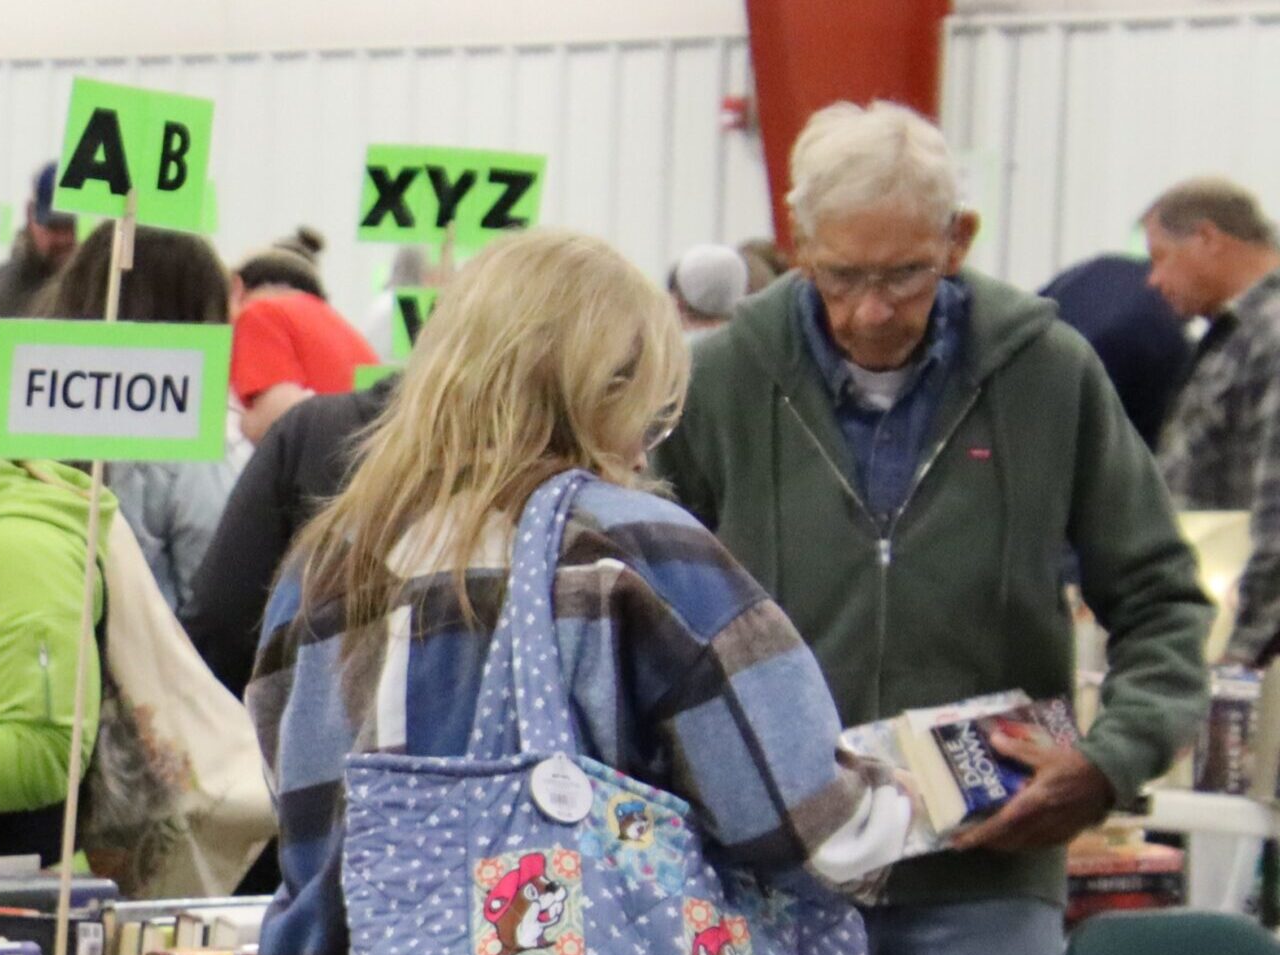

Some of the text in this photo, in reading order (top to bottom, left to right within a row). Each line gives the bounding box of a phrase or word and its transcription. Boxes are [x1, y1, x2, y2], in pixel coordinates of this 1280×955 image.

[58, 106, 191, 197] A B
[360, 163, 538, 230] XYZ
[24, 367, 190, 415] FICTION
